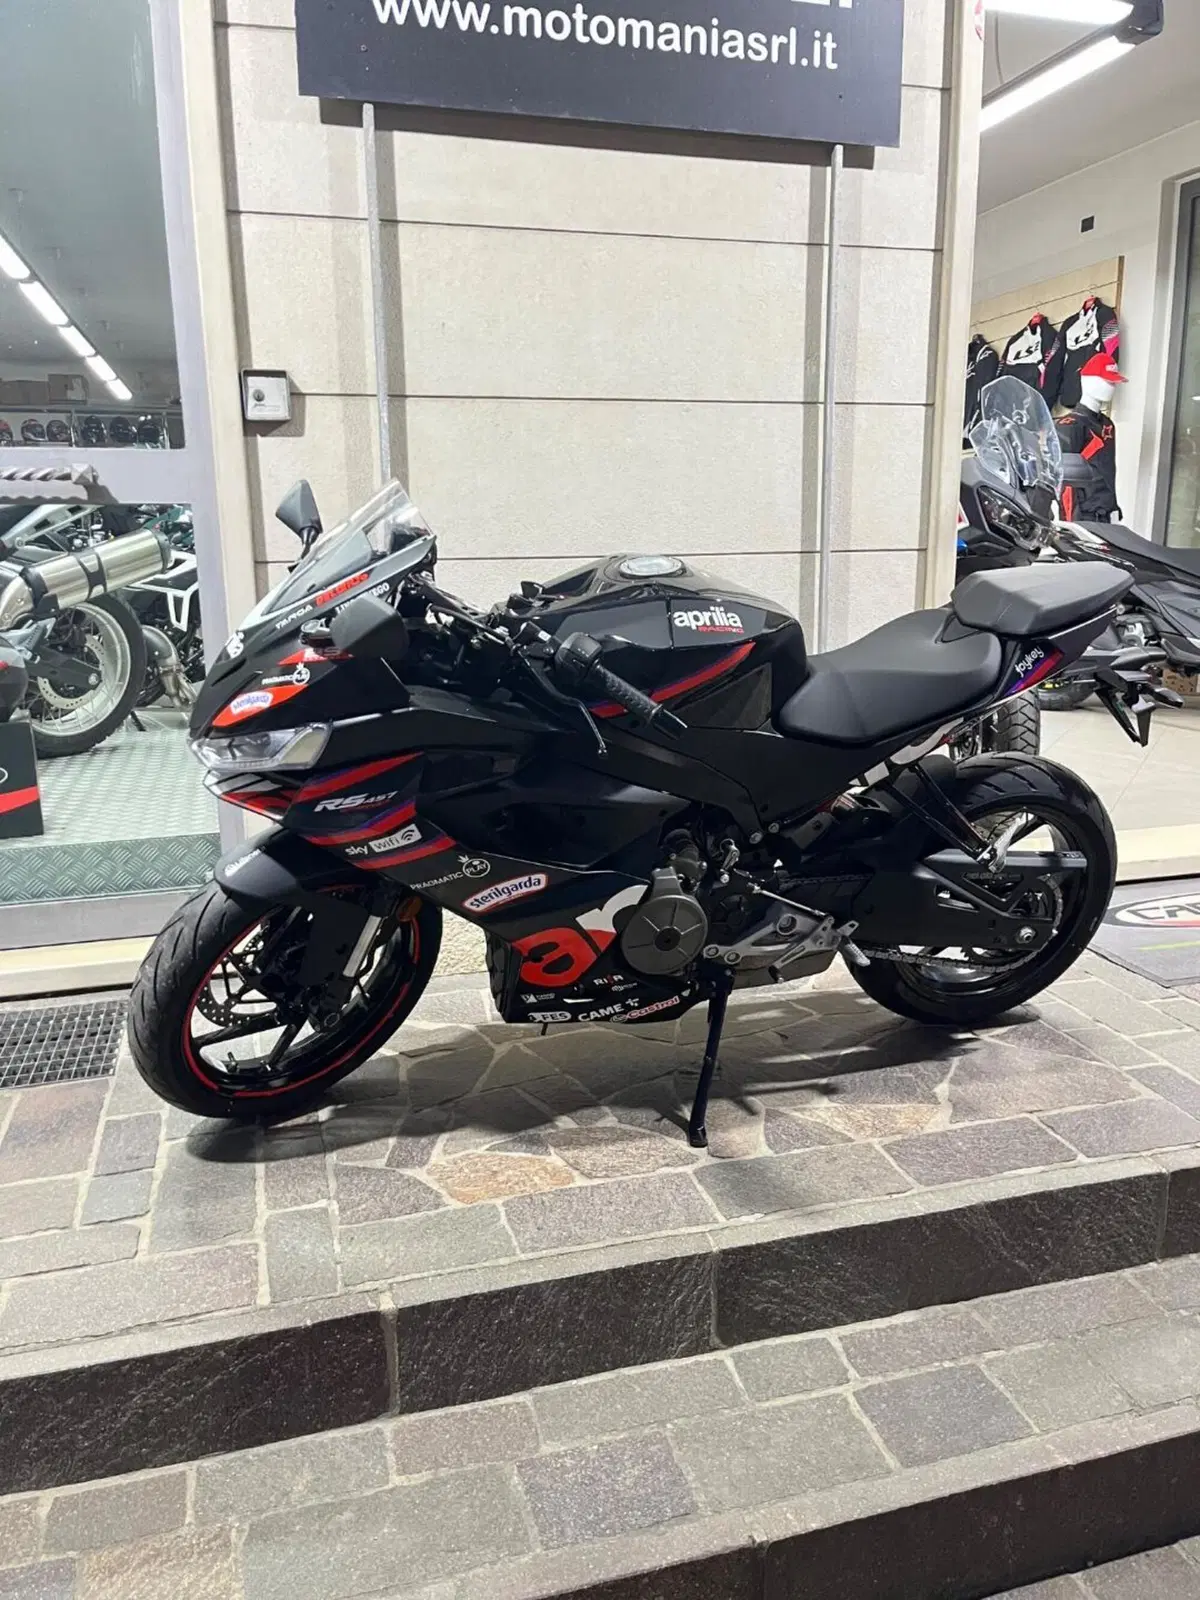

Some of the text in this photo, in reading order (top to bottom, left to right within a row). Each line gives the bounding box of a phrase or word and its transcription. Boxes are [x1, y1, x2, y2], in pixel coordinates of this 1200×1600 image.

[373, 0, 838, 70] www.motomaniasrl.it
[673, 606, 743, 630] aprilia
[345, 836, 400, 855] sky wifi
[470, 876, 541, 909] sterilgarda
[578, 1003, 624, 1022] CAME
